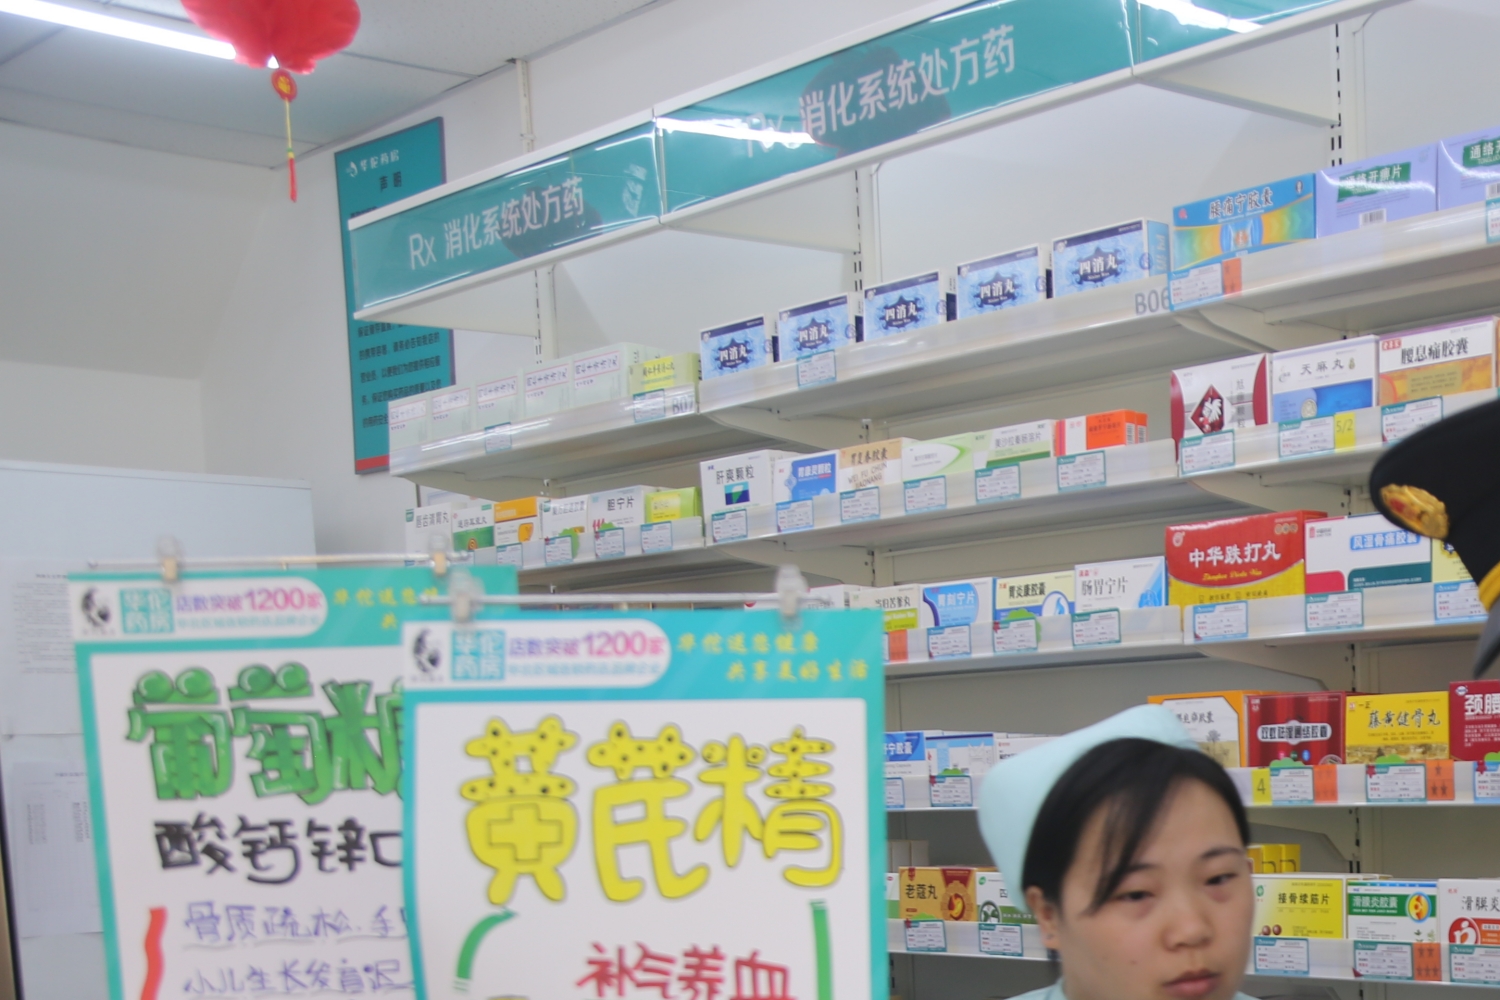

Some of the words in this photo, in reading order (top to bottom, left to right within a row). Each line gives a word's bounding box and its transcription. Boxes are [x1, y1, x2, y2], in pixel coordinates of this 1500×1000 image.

[800, 24, 1014, 137] 消化系统处方药
[1209, 187, 1273, 219] 腰痛宁胶囊
[409, 233, 437, 270] Rx
[443, 176, 584, 259] 消化系统处方药
[1079, 252, 1118, 275] 四消丸
[980, 279, 1015, 299] 四消丸
[885, 302, 918, 320] 四消丸
[799, 323, 829, 342] 四消丸
[719, 344, 748, 363] 四消丸
[1401, 337, 1468, 365] 腰息痛胶囊
[1300, 358, 1344, 376] 天麻丸
[716, 465, 755, 485] 肝爽颗粒
[607, 495, 635, 511] 胆宁片
[1189, 540, 1281, 568] 中华跌打丸
[1008, 581, 1047, 599] 胃炎康胶囊
[1081, 577, 1129, 597] 肠胃宁片
[1368, 708, 1441, 729] 藤黄健骨丸
[460, 713, 844, 906] 黄芪精
